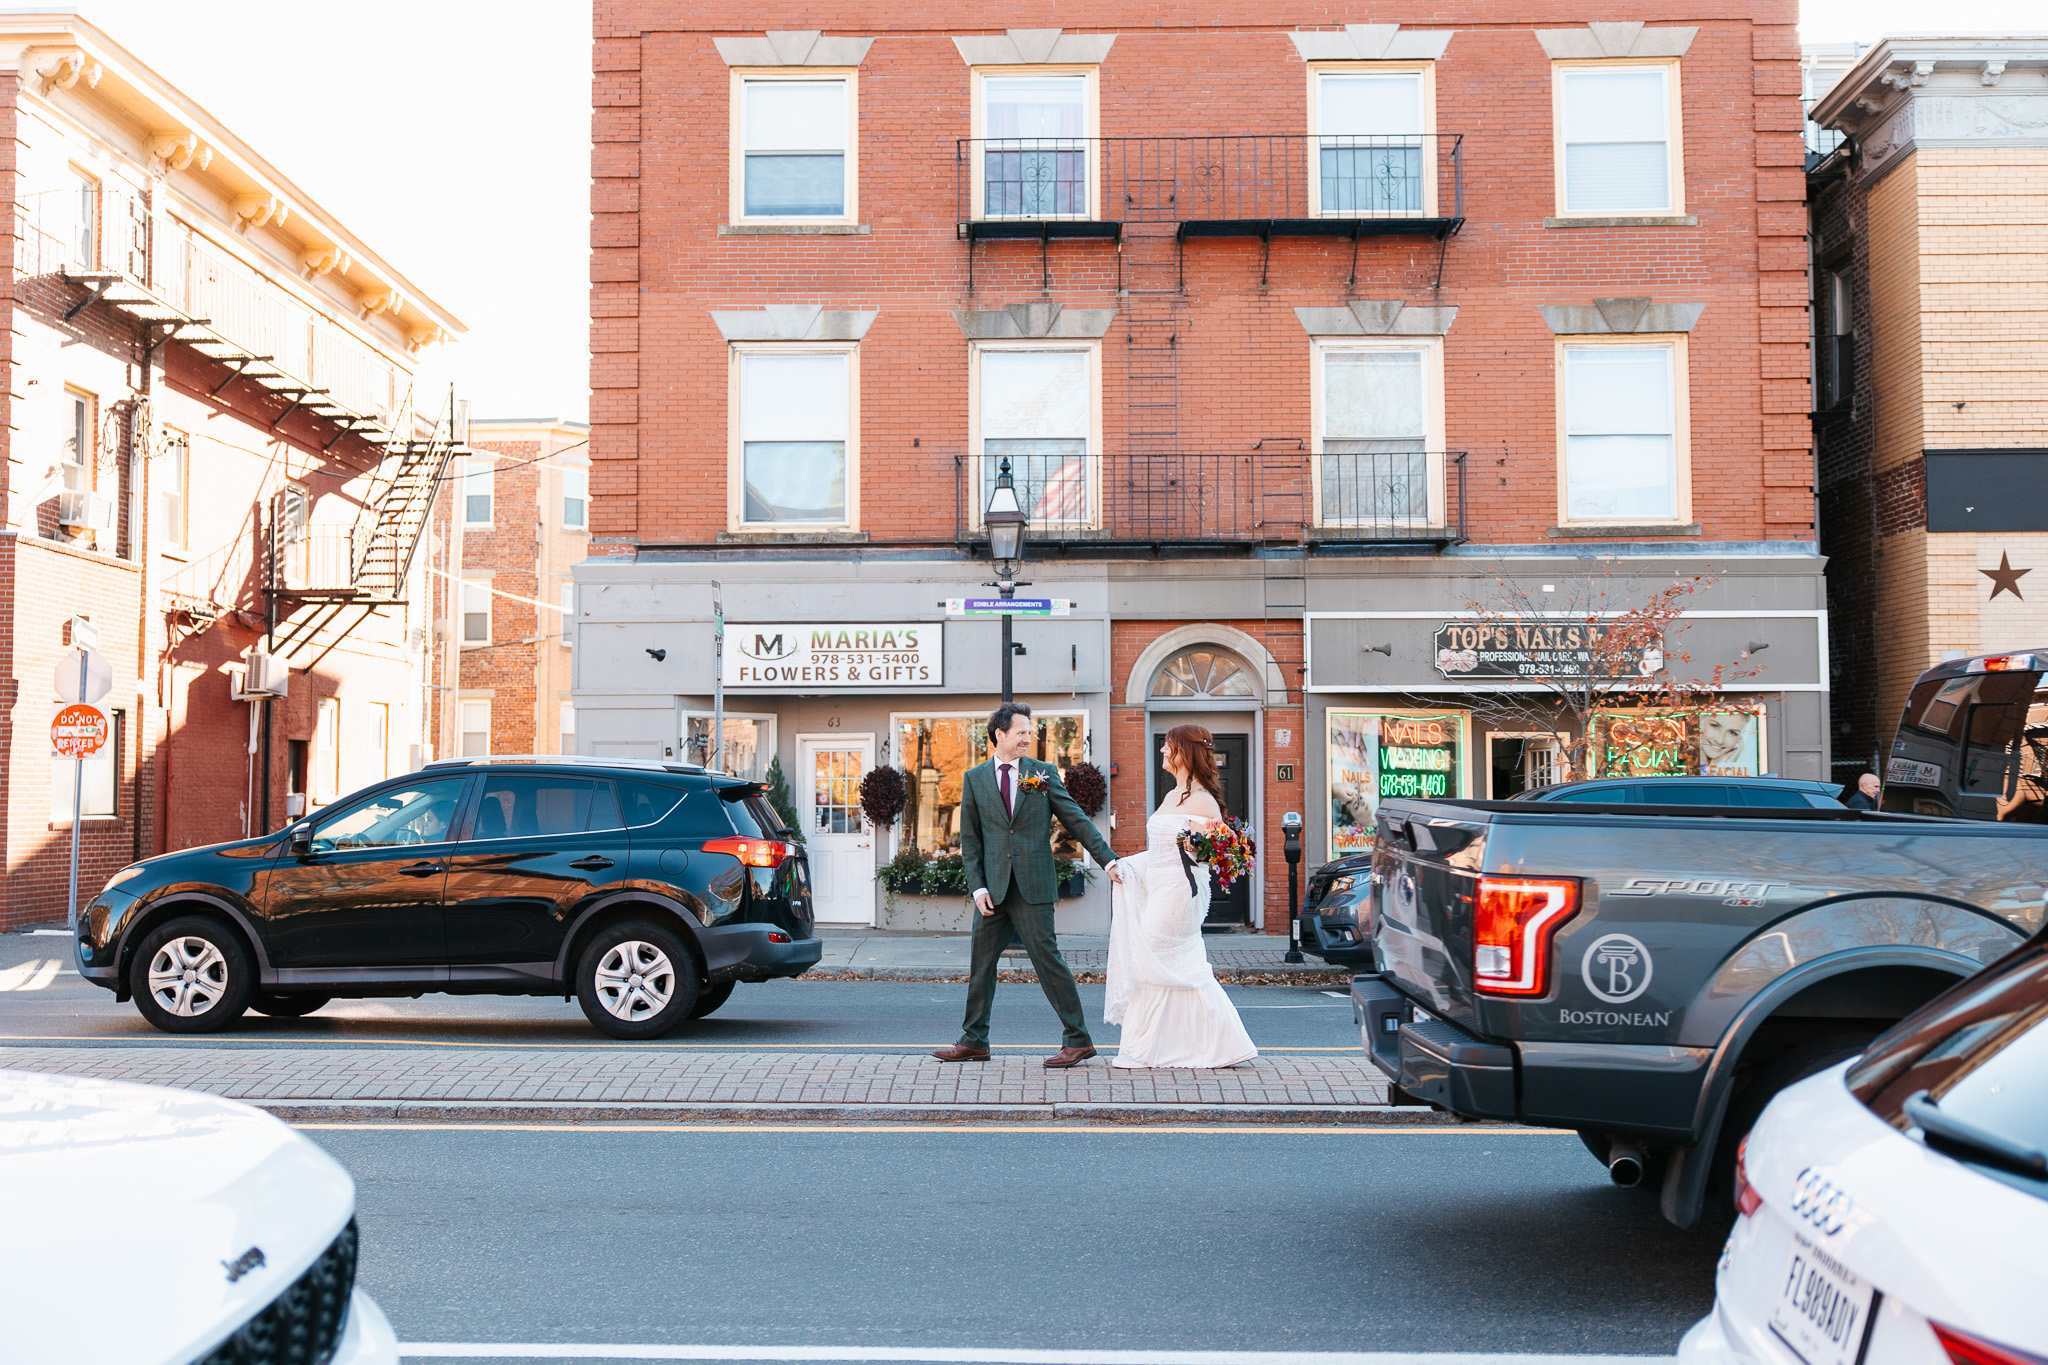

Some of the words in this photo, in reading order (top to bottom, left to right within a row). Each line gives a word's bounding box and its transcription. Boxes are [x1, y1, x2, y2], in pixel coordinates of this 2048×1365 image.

[755, 634, 783, 656] M
[811, 629, 919, 649] MARIA'S
[1447, 626, 1509, 650] TOP'S
[1515, 626, 1581, 650] NAILS
[811, 653, 920, 665] 978-531-5400
[1480, 651, 1532, 662] PROFESSIONAL
[740, 666, 839, 682] FLOWERS
[847, 667, 860, 681] &
[869, 666, 929, 681] GIFTS
[61, 715, 75, 724] DO
[79, 715, 99, 724] NOT
[828, 717, 840, 727] 63
[1384, 722, 1442, 745] NAILS
[1380, 748, 1446, 770] WAXING
[1279, 766, 1291, 779] 61
[1342, 769, 1371, 783] NAILS
[1709, 764, 1750, 777] FACIAL
[1380, 774, 1445, 796] 978-531-4460
[1607, 878, 1790, 898] SPORT
[1606, 956, 1633, 994] B
[1560, 1009, 1669, 1027] BOSTONEAN
